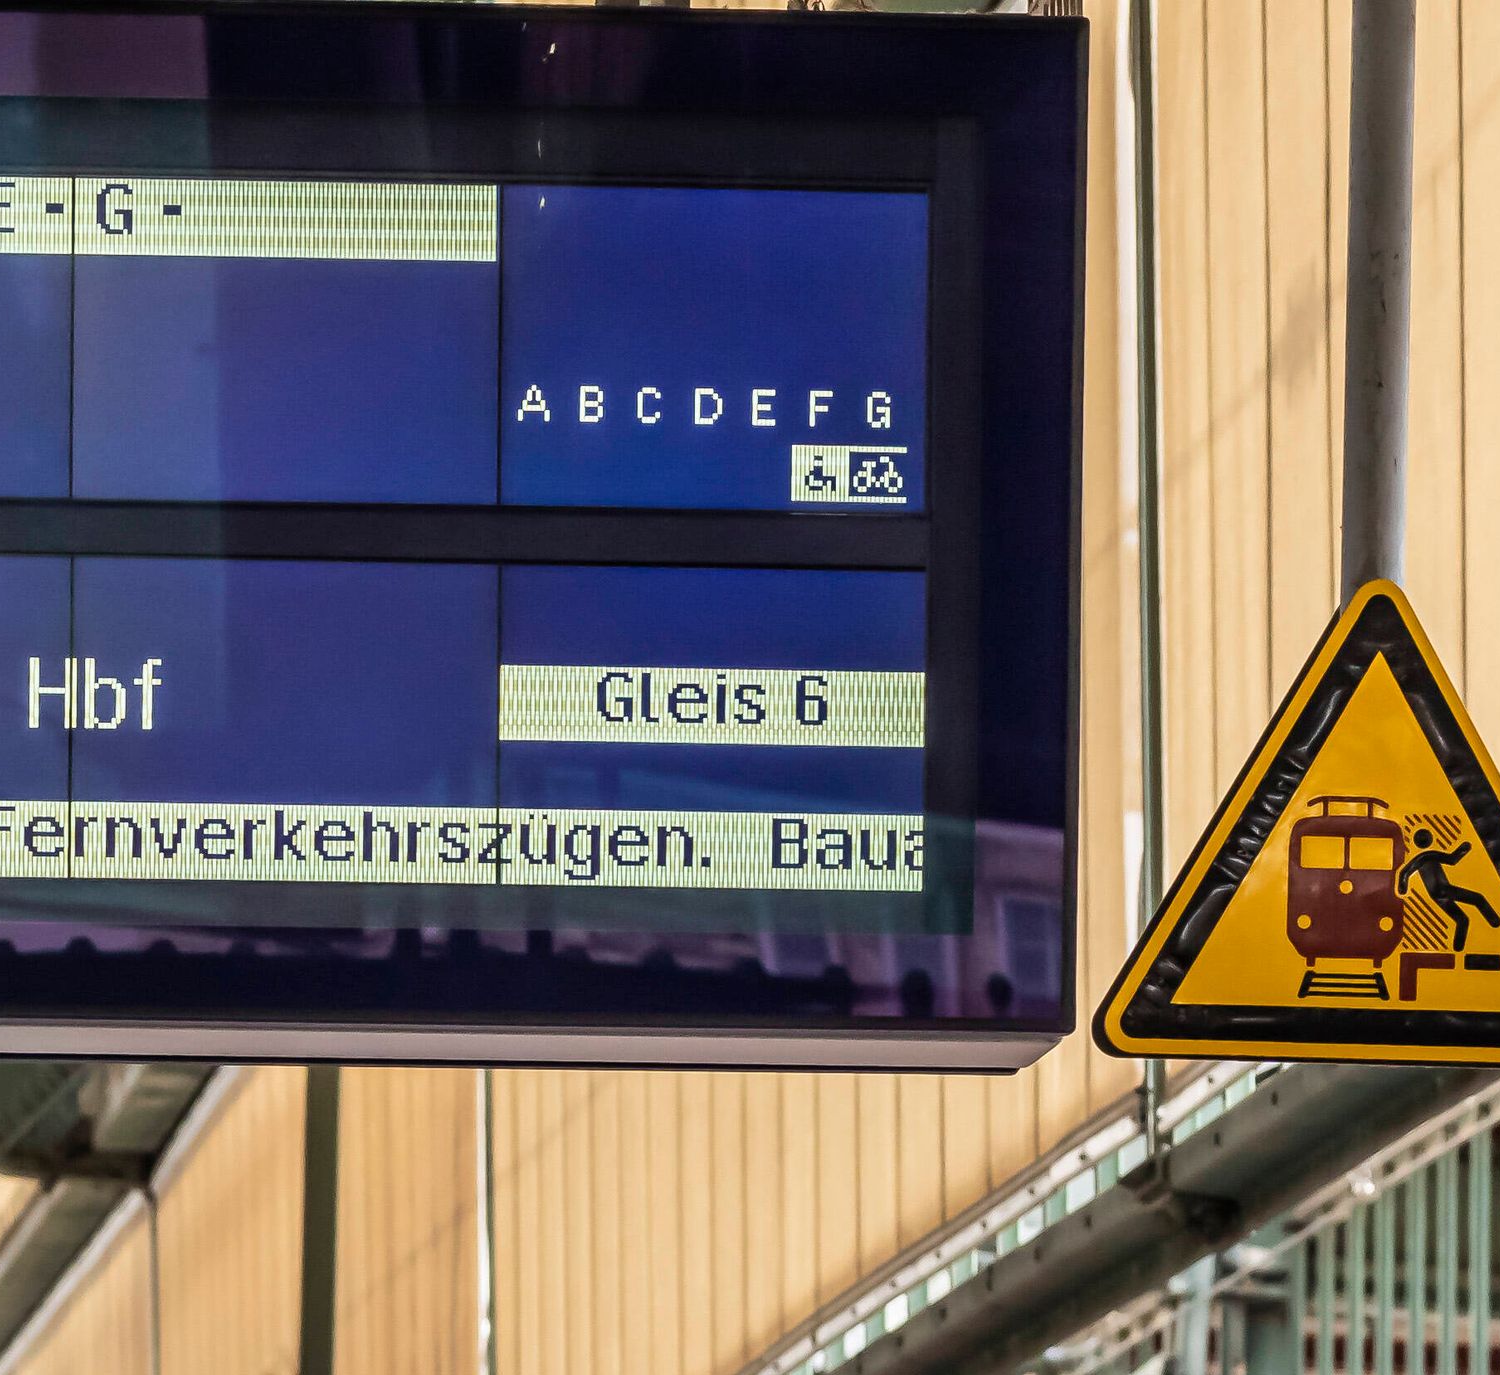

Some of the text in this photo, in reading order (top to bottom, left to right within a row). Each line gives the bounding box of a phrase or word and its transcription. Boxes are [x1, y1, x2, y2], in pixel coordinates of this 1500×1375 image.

[97, 184, 132, 234] G
[518, 385, 890, 427] A B C D E F G
[29, 658, 161, 729] Hbf
[597, 672, 765, 724] Gleis
[796, 676, 827, 725] 6
